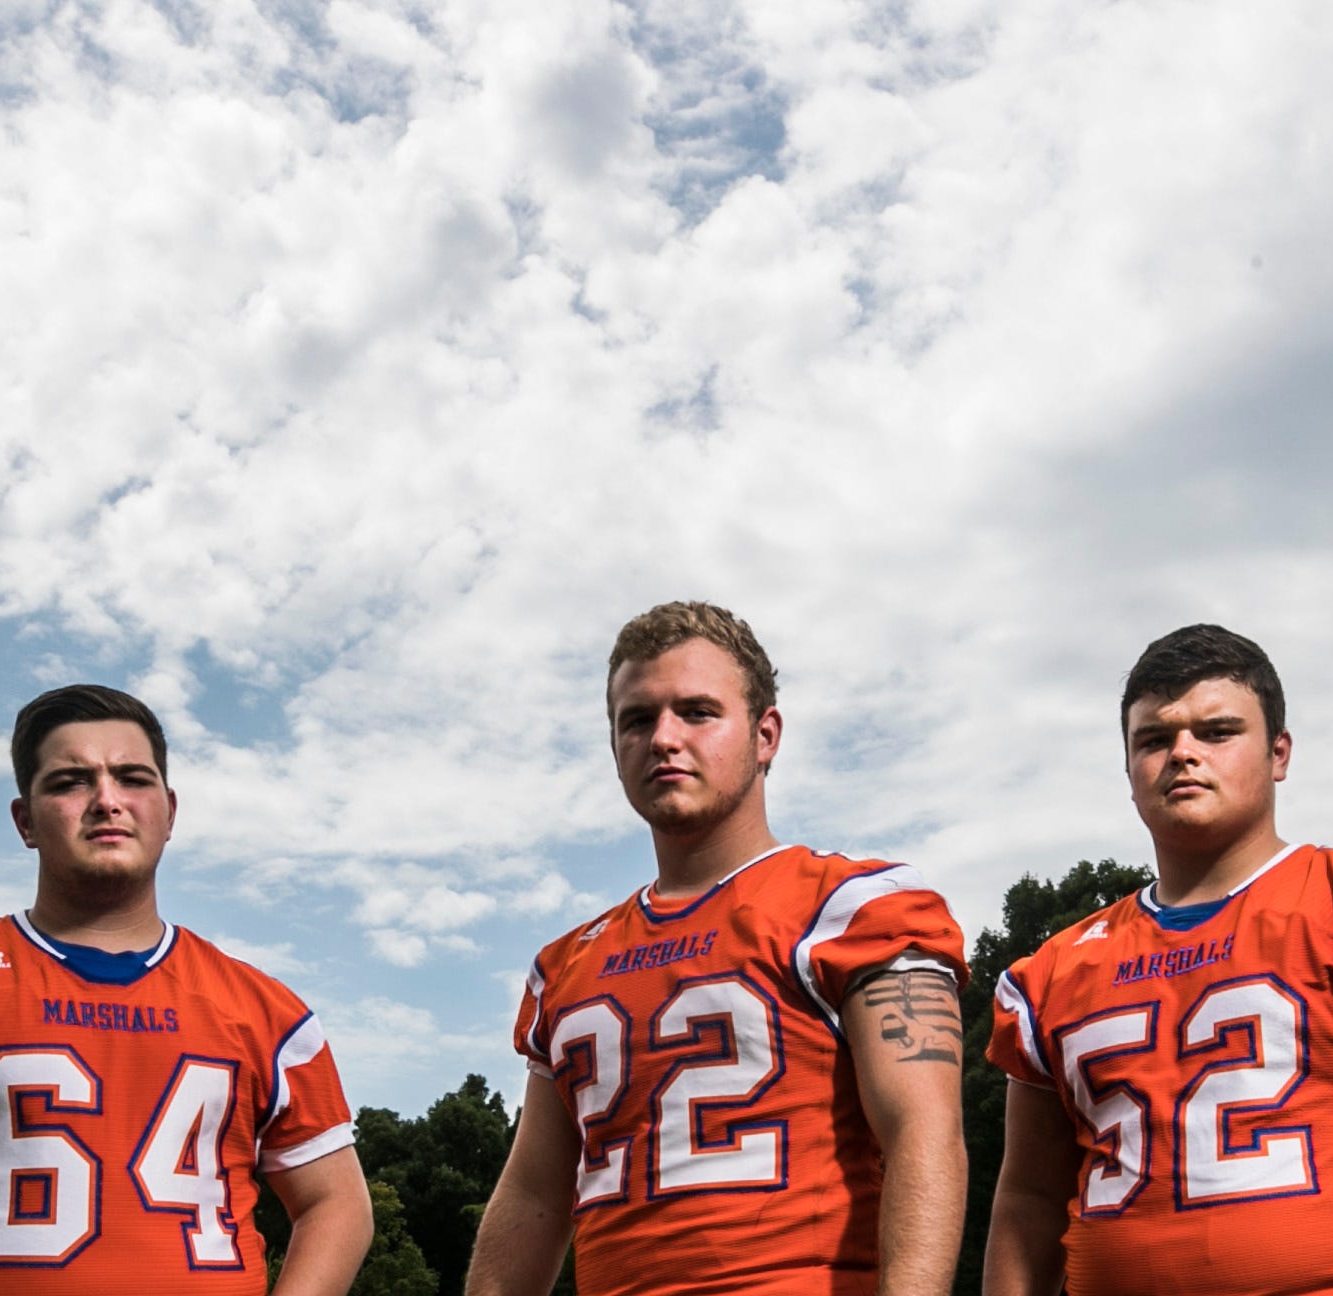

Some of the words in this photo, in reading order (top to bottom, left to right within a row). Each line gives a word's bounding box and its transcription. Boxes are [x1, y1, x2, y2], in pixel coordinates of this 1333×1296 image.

[598, 930, 718, 979] MARSHALS
[1113, 934, 1235, 986] MARSHALS
[43, 999, 179, 1032] MARSHALS
[549, 971, 791, 1217] 22
[1053, 973, 1320, 1218] 52
